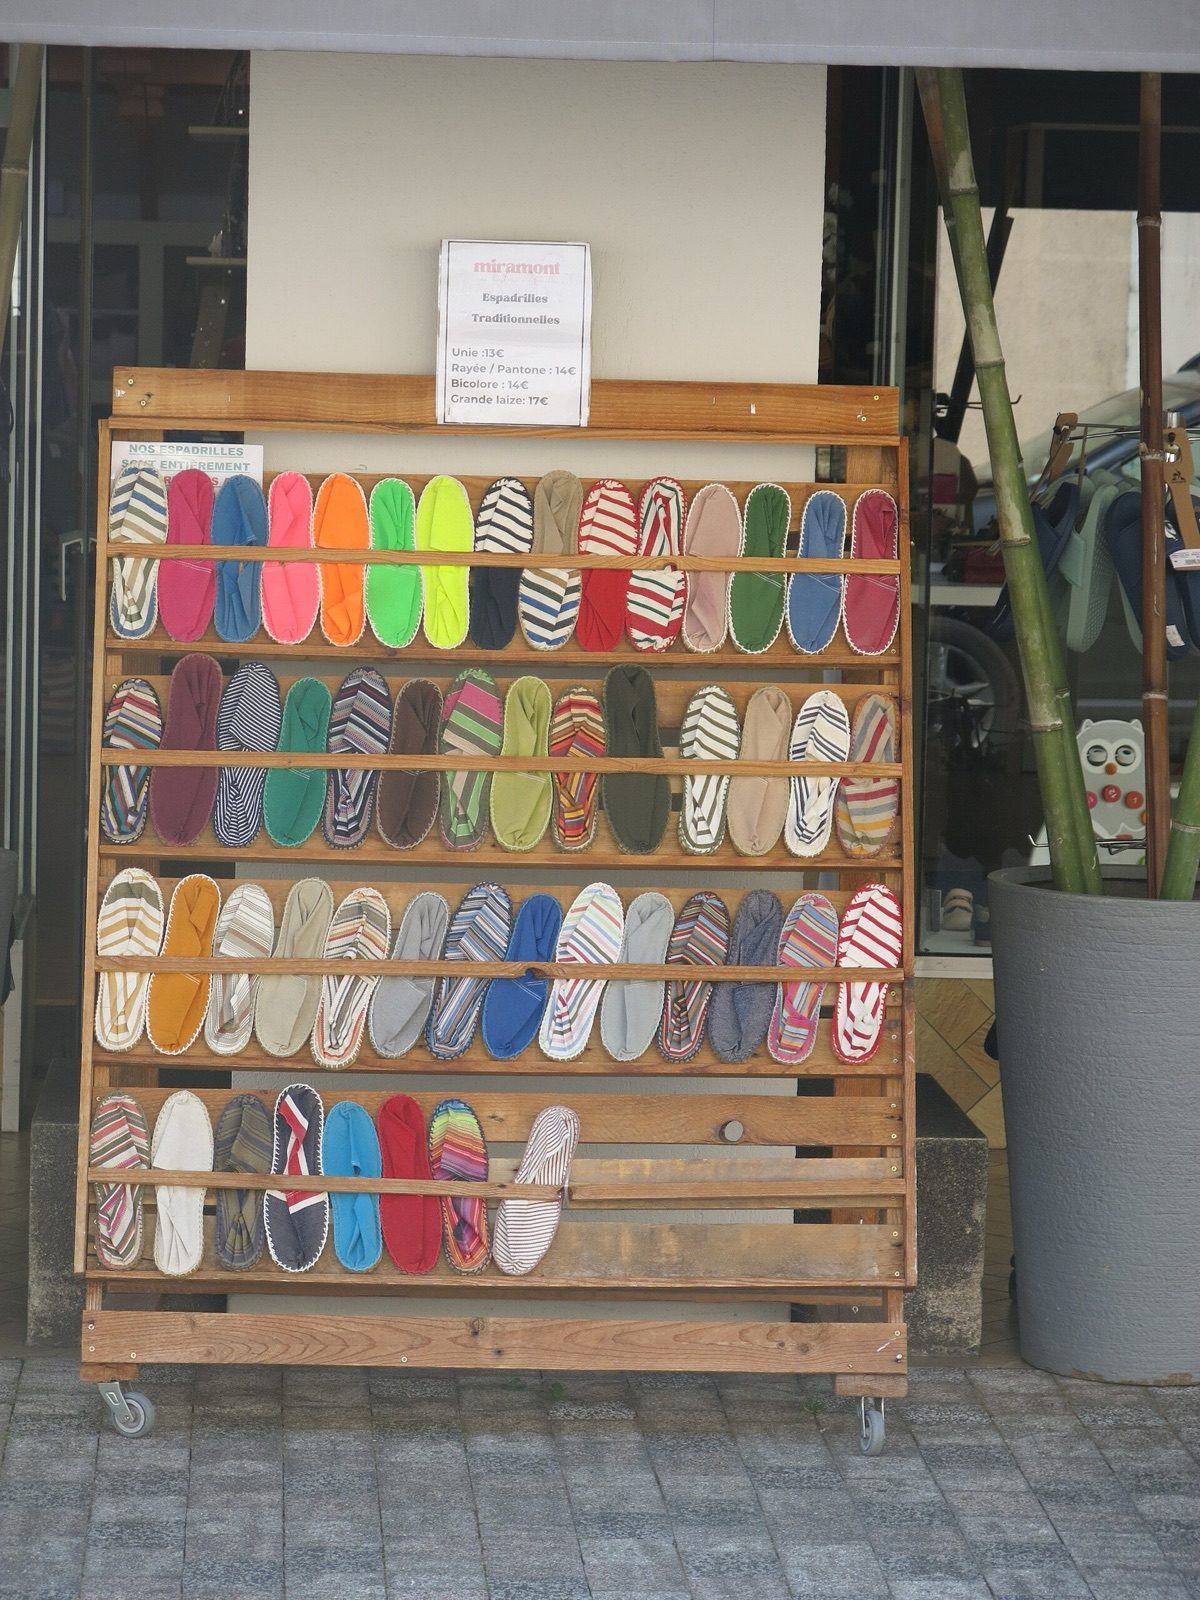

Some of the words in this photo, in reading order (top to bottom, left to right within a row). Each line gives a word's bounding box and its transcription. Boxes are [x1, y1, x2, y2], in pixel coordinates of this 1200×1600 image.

[482, 293, 548, 304] Espadrilles
[471, 313, 560, 325] Traditionnelles
[452, 347, 478, 358] Unie
[451, 363, 487, 375] Rayée
[497, 364, 546, 375] Pantone
[555, 366, 577, 376] 14€
[451, 379, 499, 389] Bicolore
[508, 380, 529, 390] 14€
[450, 394, 493, 404] Grande
[496, 395, 526, 405] laize:
[528, 396, 549, 406] 17€
[129, 444, 155, 454] NOS
[159, 445, 244, 457] ESPADRILLES
[160, 459, 251, 472] ENTIÈREMENT
